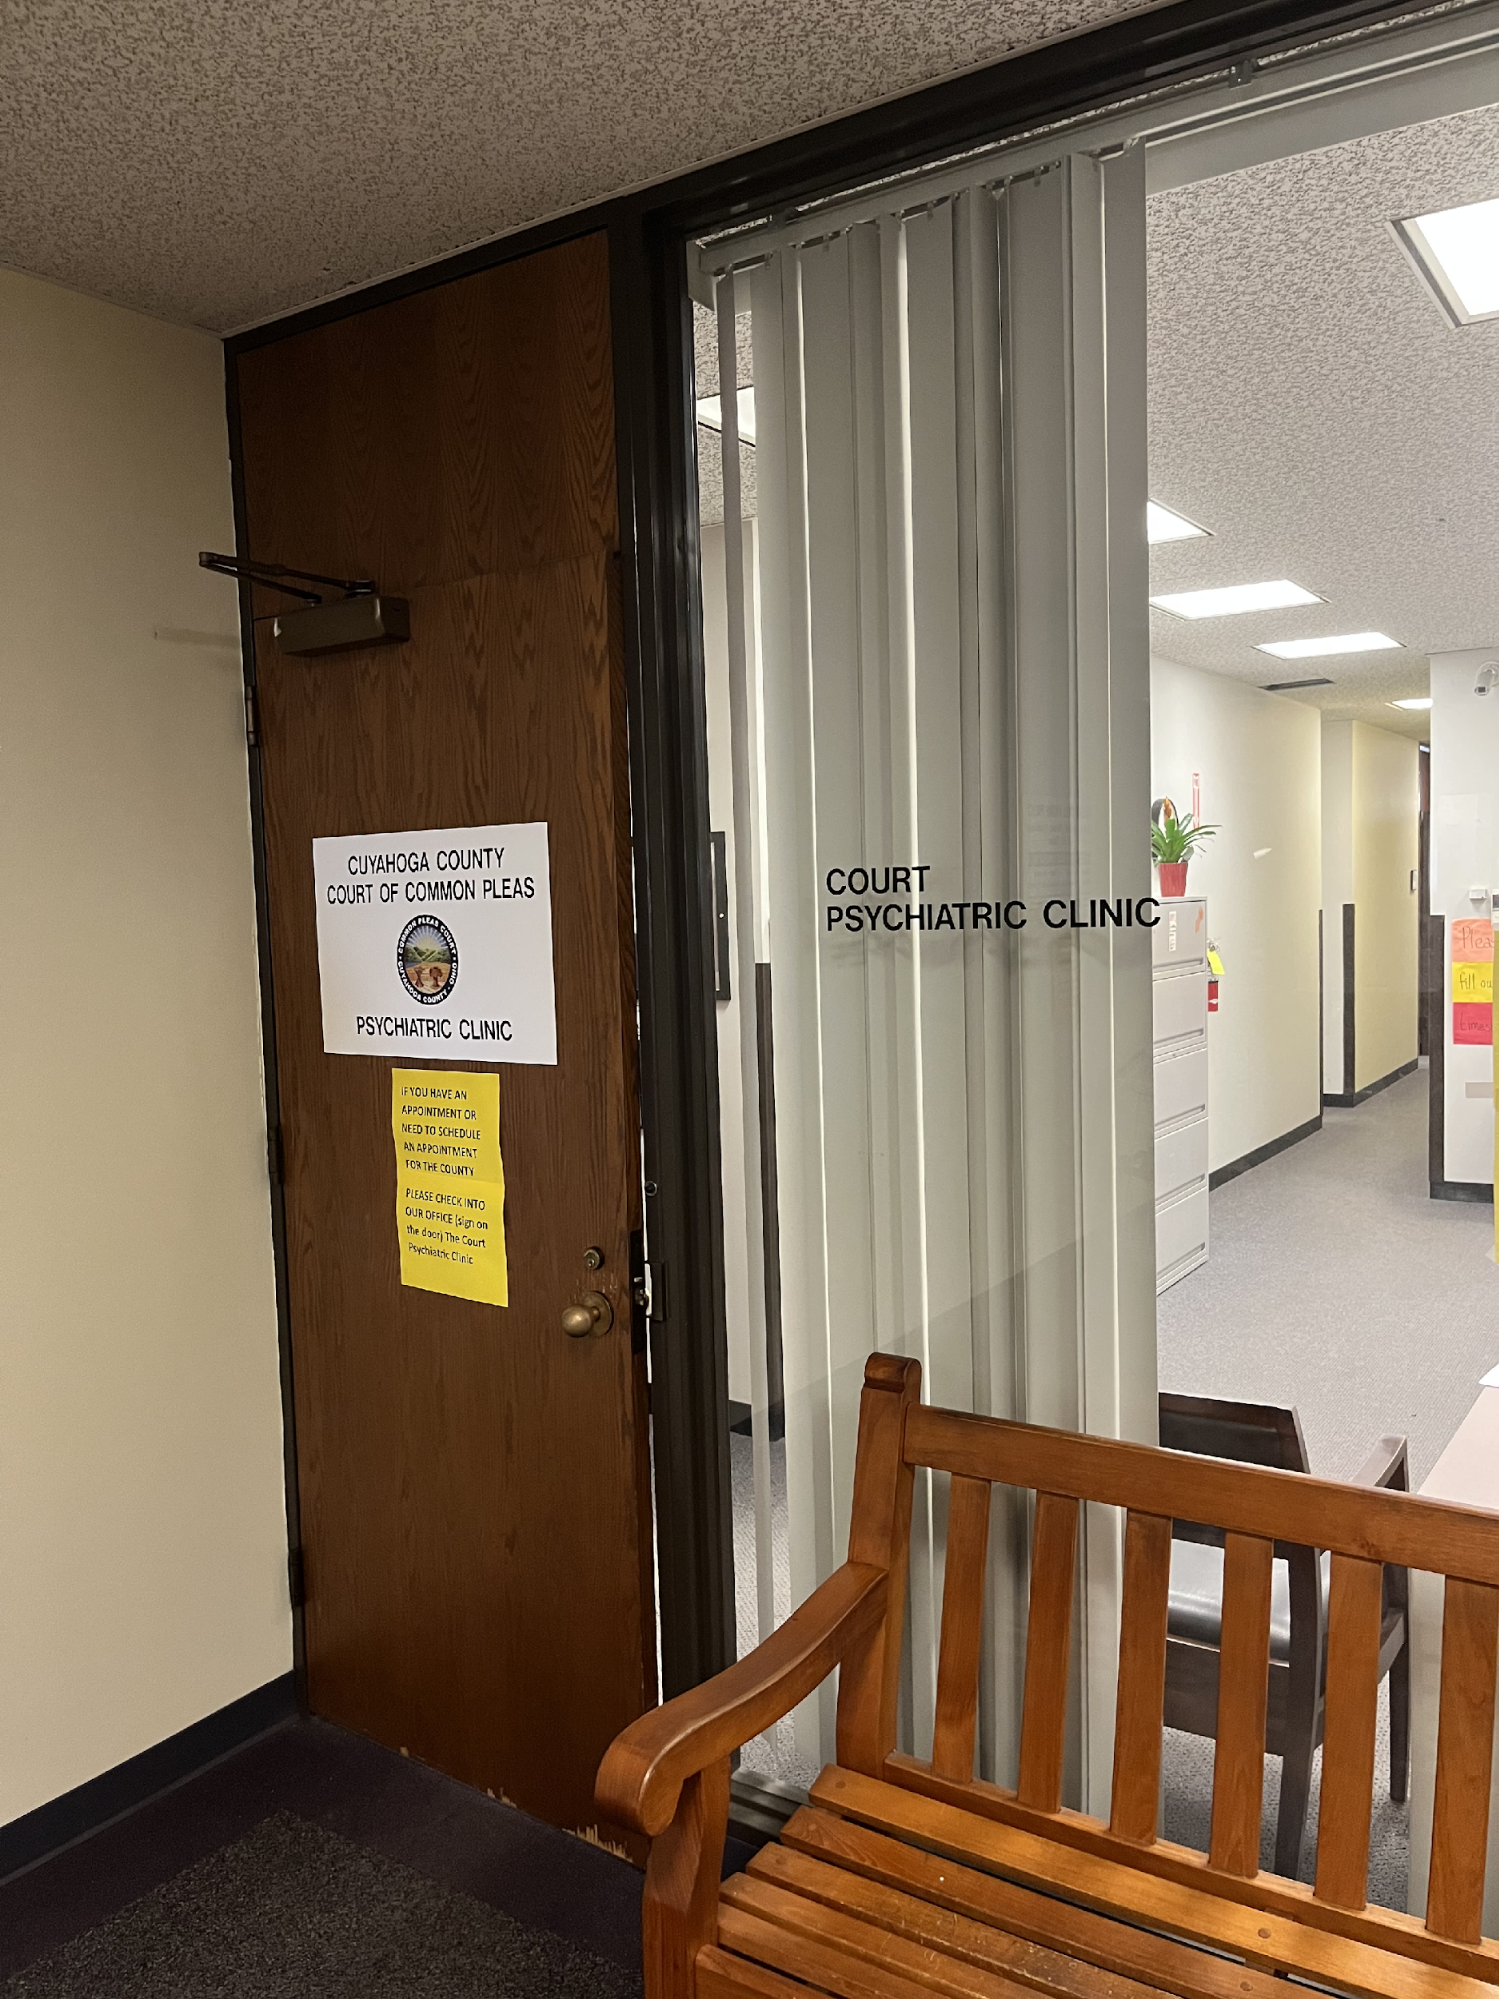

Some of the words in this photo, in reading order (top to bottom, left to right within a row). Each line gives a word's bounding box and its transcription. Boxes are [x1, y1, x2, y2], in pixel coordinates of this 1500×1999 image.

[348, 852, 429, 875] CUYAHOGA
[437, 848, 505, 870] COUNTY
[327, 884, 373, 904] COURT
[380, 883, 399, 902] OF
[405, 880, 476, 902] COMMON
[483, 877, 535, 899] PLEAS
[826, 866, 931, 896] COURT
[827, 900, 1027, 932] PSYCHIATRIC
[1043, 897, 1161, 929] CLINIC
[398, 920, 417, 954] COMMON
[418, 917, 439, 928] PLEAS
[440, 926, 456, 955] COURT
[398, 961, 422, 1001] CUYAHOGA
[423, 990, 448, 1004] COUNTY
[449, 962, 458, 985] OHIO
[1459, 971, 1475, 990] fill
[1480, 979, 1493, 988] ou
[357, 1016, 452, 1039] PSYCHIATRIC
[460, 1020, 512, 1041] CLINIC
[1460, 1012, 1493, 1032] times
[401, 1086, 408, 1096] IF
[410, 1087, 428, 1098] YOU
[430, 1088, 452, 1100] HAVE
[454, 1090, 467, 1100] AN
[402, 1106, 462, 1120] APPOINTMENT
[464, 1109, 476, 1121] OR
[402, 1123, 423, 1135] NEED
[425, 1125, 436, 1136] TO
[438, 1126, 481, 1140] SCHEDULE
[404, 1142, 415, 1152] AN
[416, 1144, 478, 1158] APPOINTMENT
[406, 1160, 421, 1170] FOR
[423, 1161, 438, 1172] THE
[440, 1163, 475, 1177] COUNTY
[406, 1188, 434, 1202] PLEASE
[436, 1193, 462, 1206] CHECK
[464, 1198, 486, 1210] INTO
[405, 1206, 424, 1218] OUR
[425, 1210, 453, 1224] OFFICE
[455, 1214, 474, 1229] (sign
[476, 1220, 488, 1230] on
[407, 1224, 420, 1236] the
[422, 1228, 443, 1243] door)
[445, 1232, 460, 1244] The
[462, 1234, 486, 1248] Court
[408, 1242, 450, 1259] Psychiatric
[451, 1250, 474, 1264] Clinic
